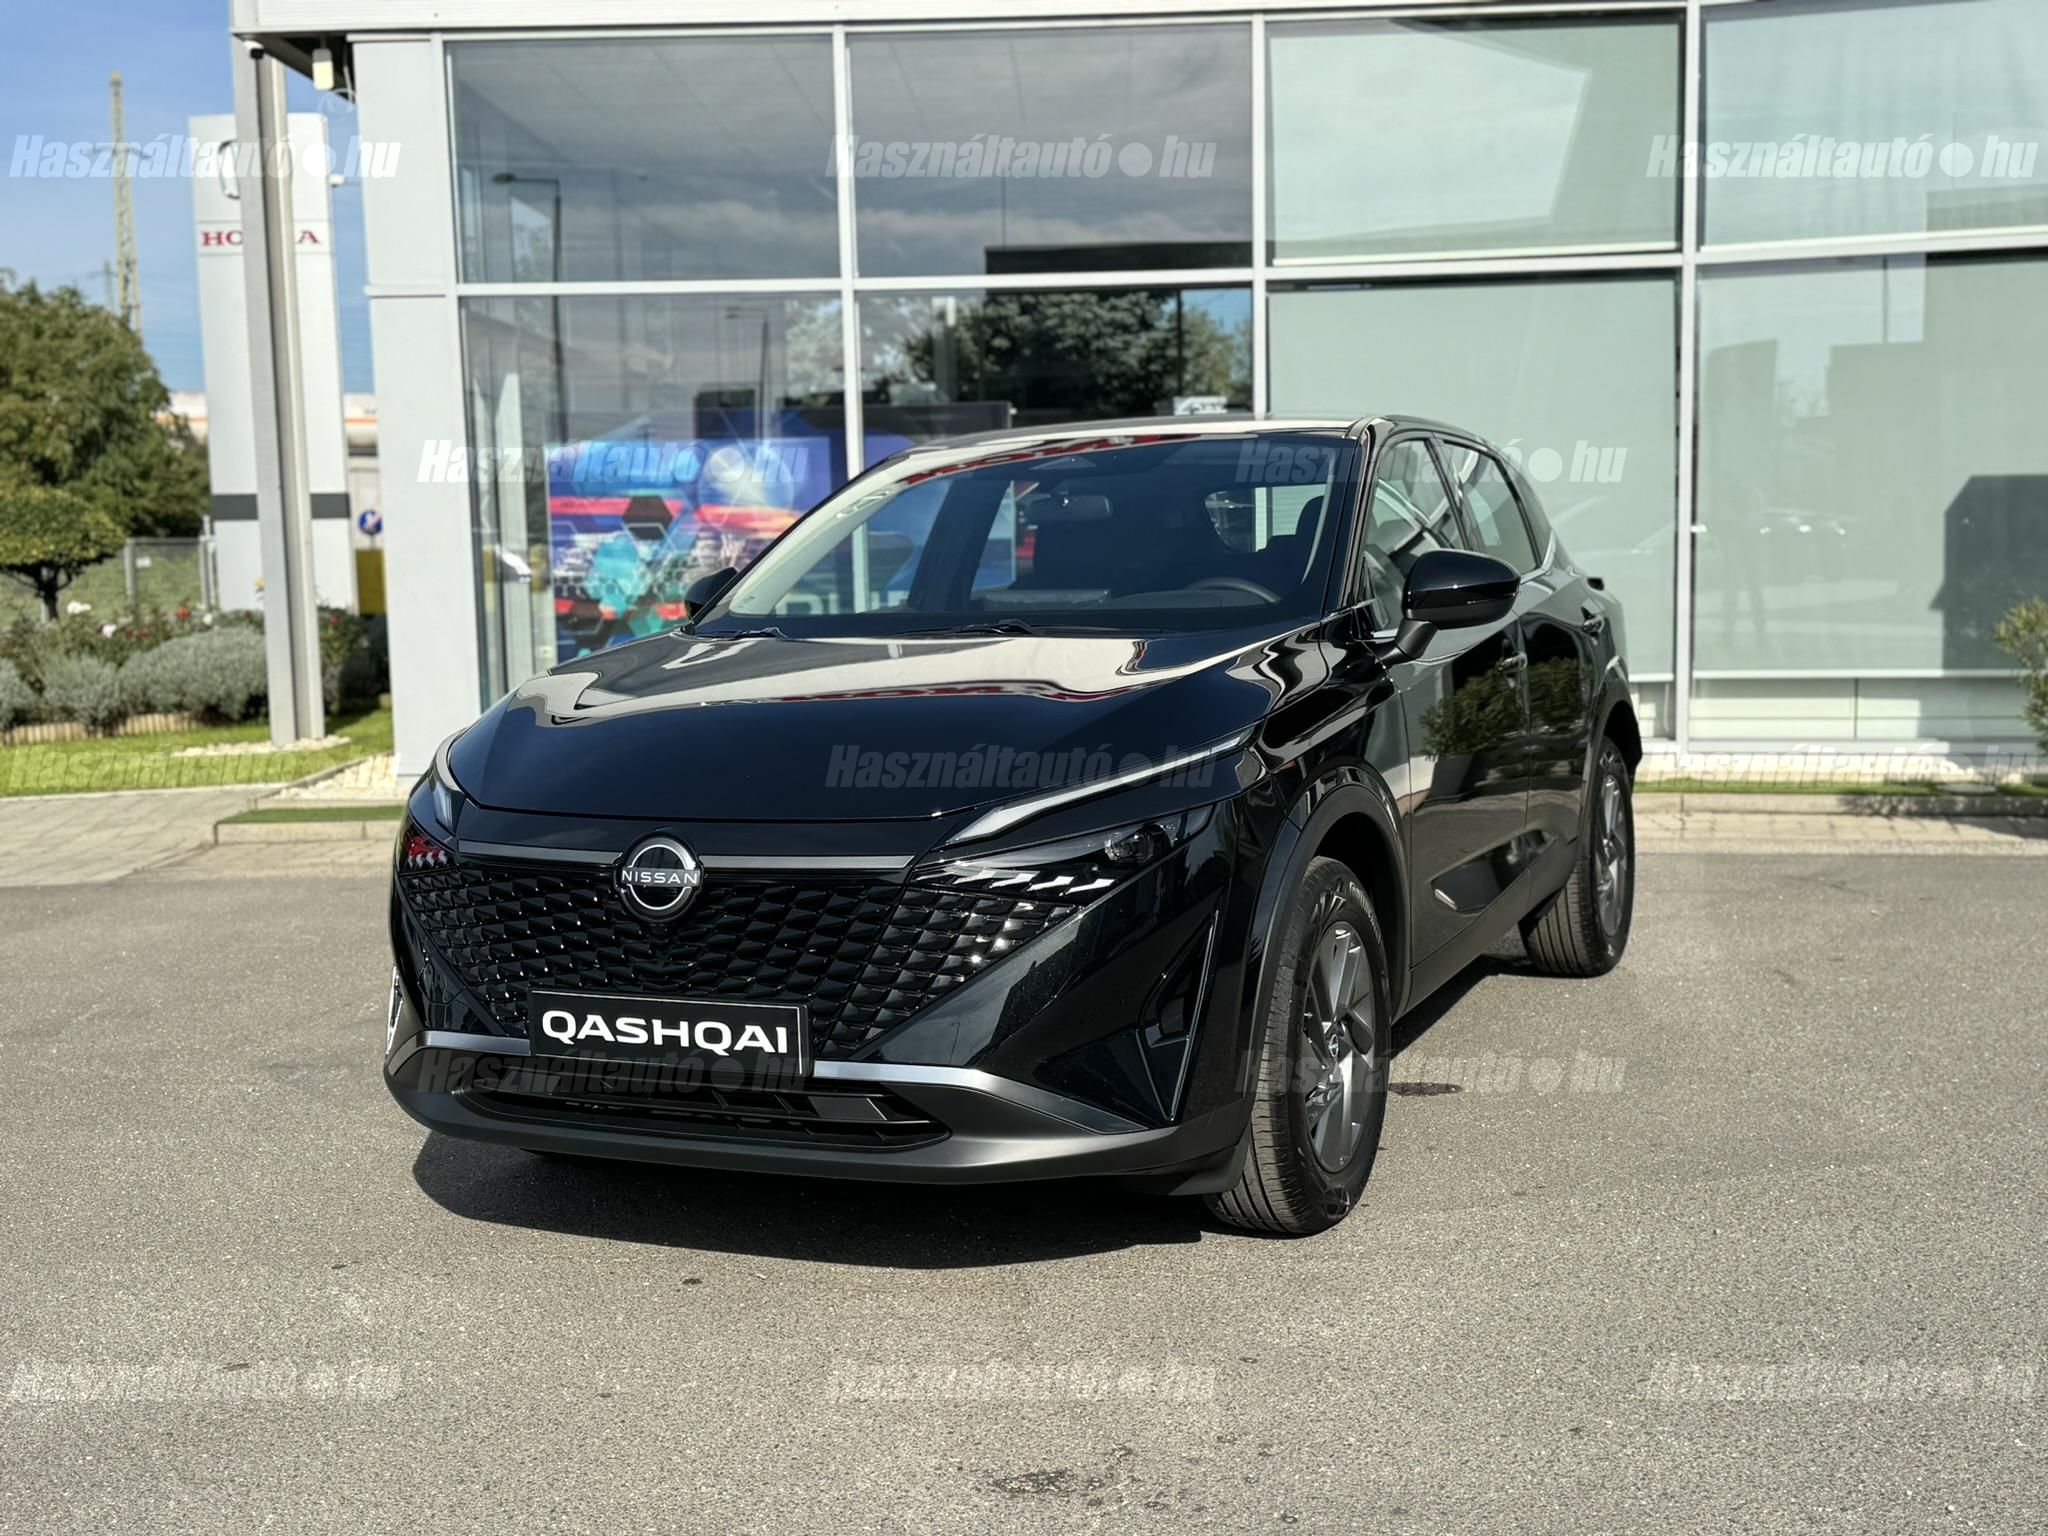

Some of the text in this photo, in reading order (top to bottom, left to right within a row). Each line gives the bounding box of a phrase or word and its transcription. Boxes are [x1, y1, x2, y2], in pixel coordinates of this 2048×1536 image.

[202, 230, 320, 246] HOA
[622, 870, 698, 884] NISSAN
[541, 1010, 788, 1056] QASHQAI
